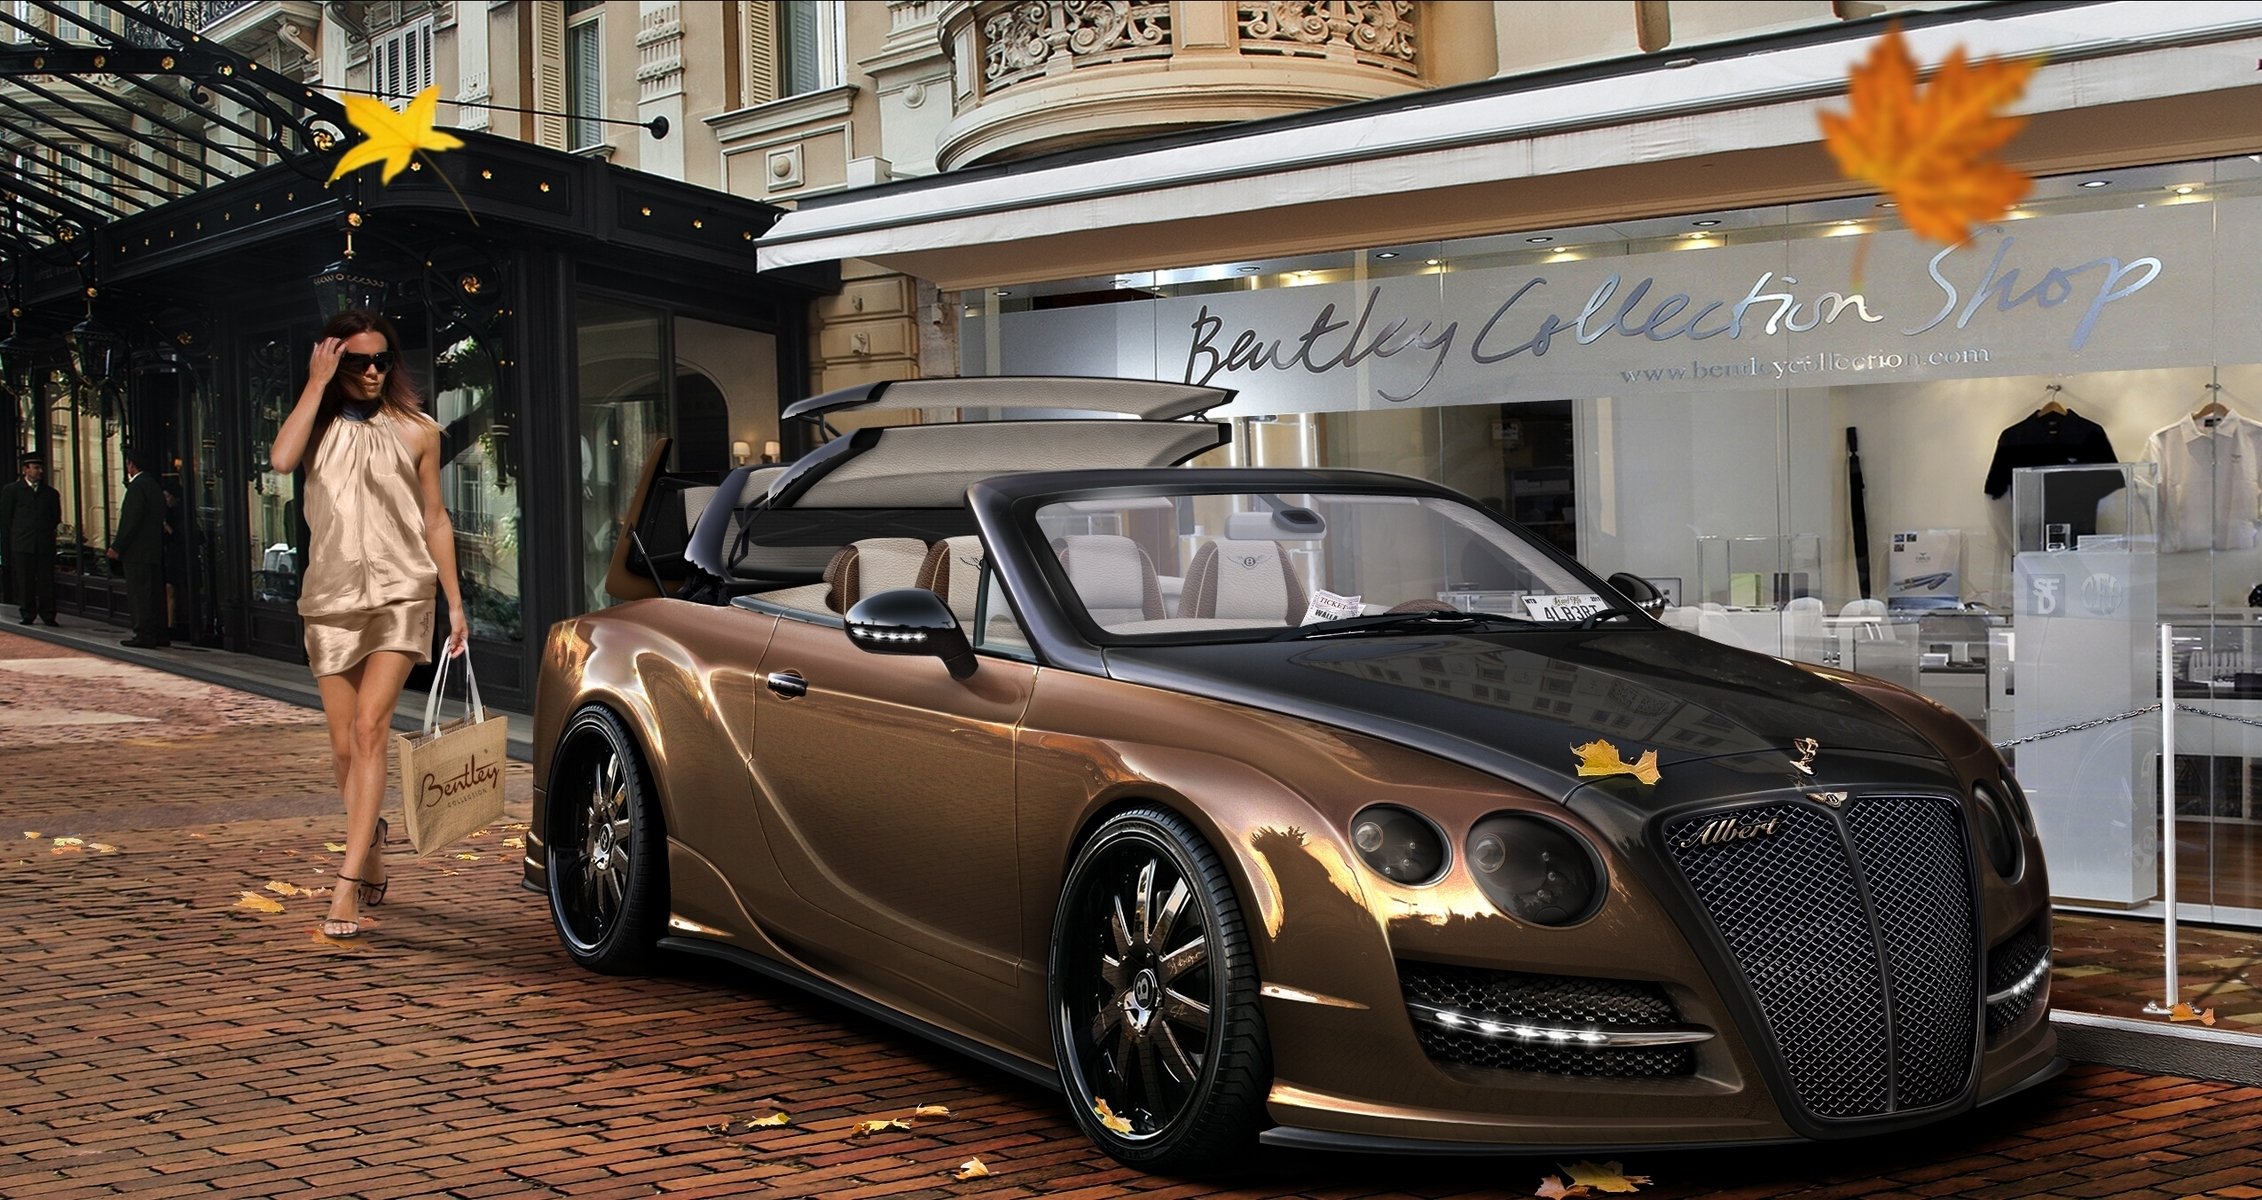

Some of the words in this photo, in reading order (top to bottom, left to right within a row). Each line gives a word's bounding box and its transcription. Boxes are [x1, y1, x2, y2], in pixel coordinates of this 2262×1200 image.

[1184, 286, 1458, 402] Bentley
[1471, 271, 1884, 364] Collection
[1902, 225, 2162, 350] Shop
[1320, 597, 1347, 610] TICKET
[416, 754, 500, 812] Bentley
[447, 787, 488, 808] COLLECTION
[1681, 817, 1780, 848] Albert
